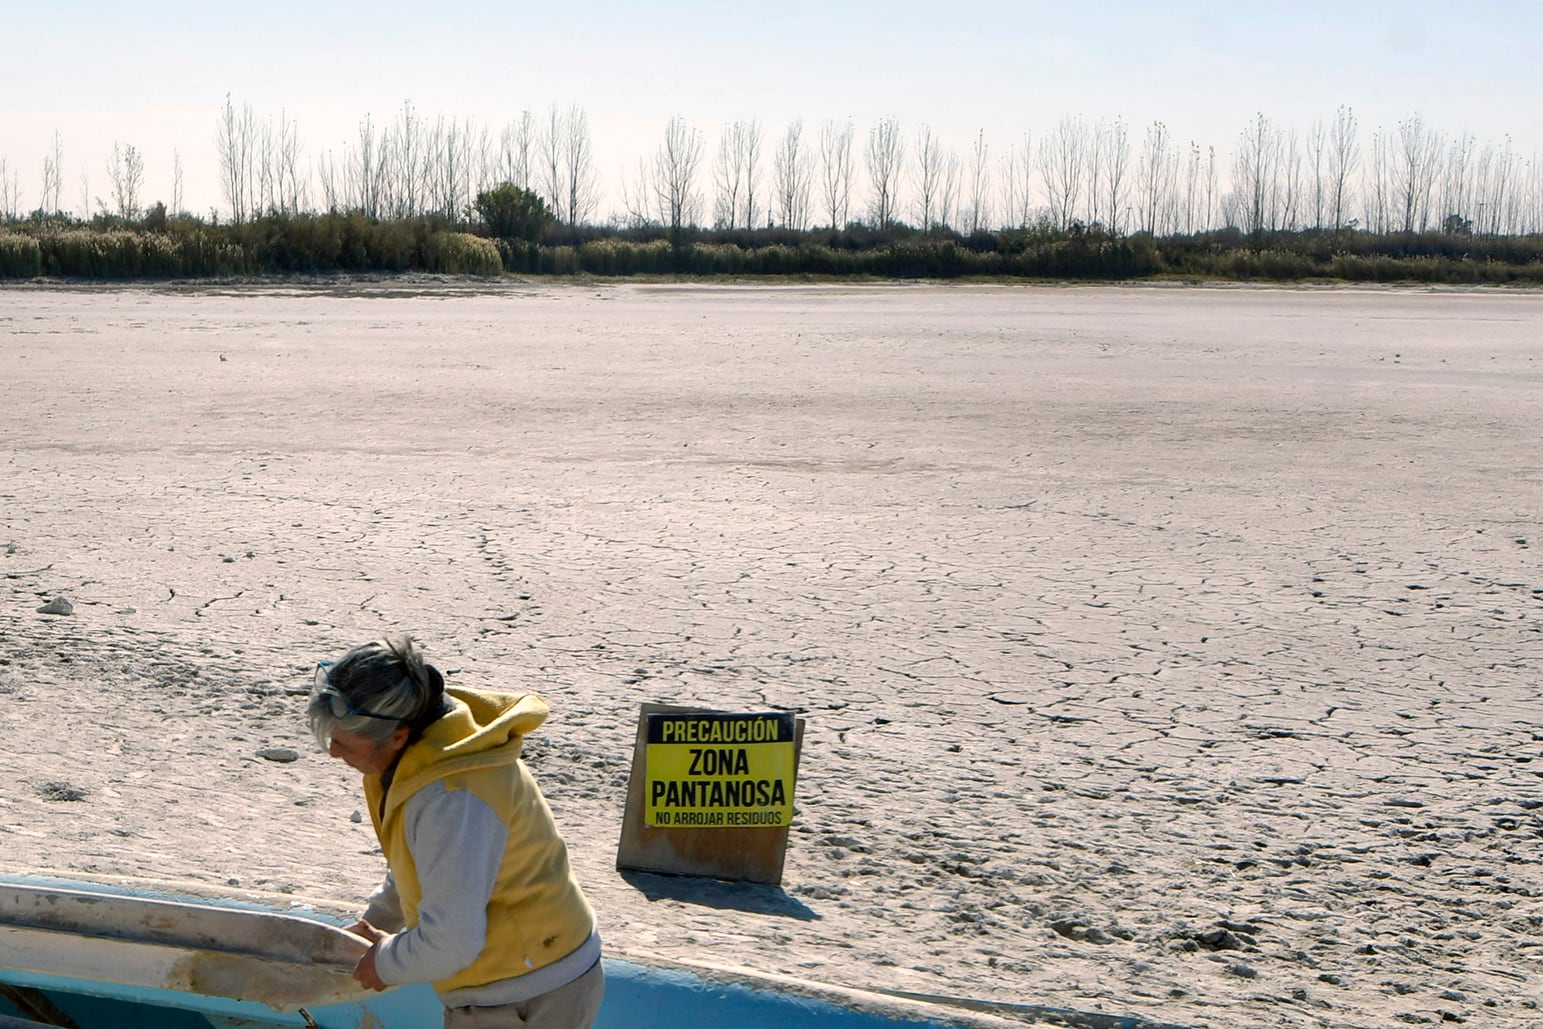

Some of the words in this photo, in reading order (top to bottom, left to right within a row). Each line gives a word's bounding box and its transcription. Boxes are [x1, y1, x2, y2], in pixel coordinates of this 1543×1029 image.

[662, 716, 779, 743] PRECAUCIÓN
[688, 748, 750, 776] ZONA
[651, 779, 786, 808] PANTANOSA
[655, 811, 671, 825] NO
[673, 811, 724, 825] ARROJAR
[727, 811, 782, 825] RESIDUOS
